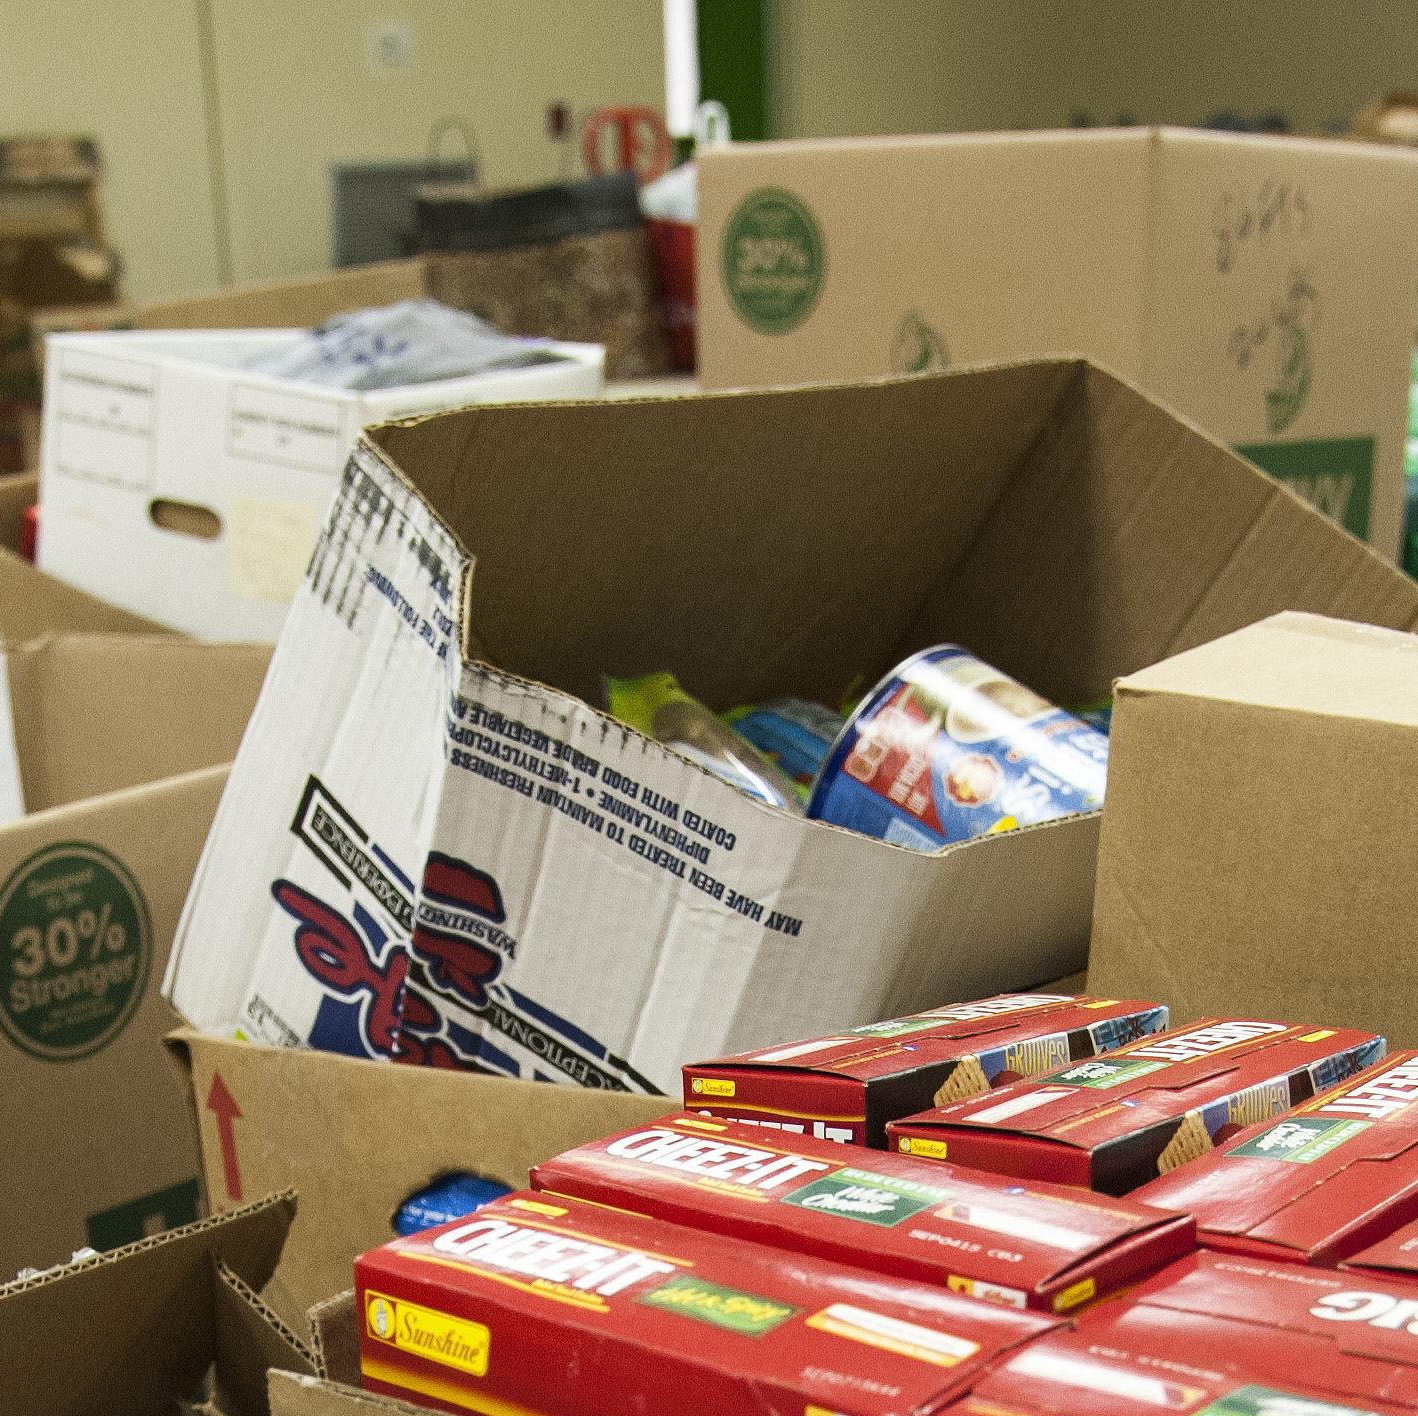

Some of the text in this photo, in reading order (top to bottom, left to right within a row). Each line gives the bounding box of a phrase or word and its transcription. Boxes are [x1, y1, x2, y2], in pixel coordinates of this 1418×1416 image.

[471, 703, 737, 851] COATED WITH FOOD GRADE VEGETABLE
[450, 747, 803, 937] MAY HAVE BEEN TREATED TO MAINTAIN FRESHNESS
[598, 790, 711, 865] DIPHENYLAMINE
[10, 904, 125, 977] 30%
[9, 951, 138, 1012] Stronger
[1125, 1020, 1288, 1062] CHEEZ-IT
[606, 1130, 832, 1191] CHEEZ-IT
[433, 1219, 676, 1298] CHEEZ-IT
[398, 1311, 482, 1366] Sunshine
